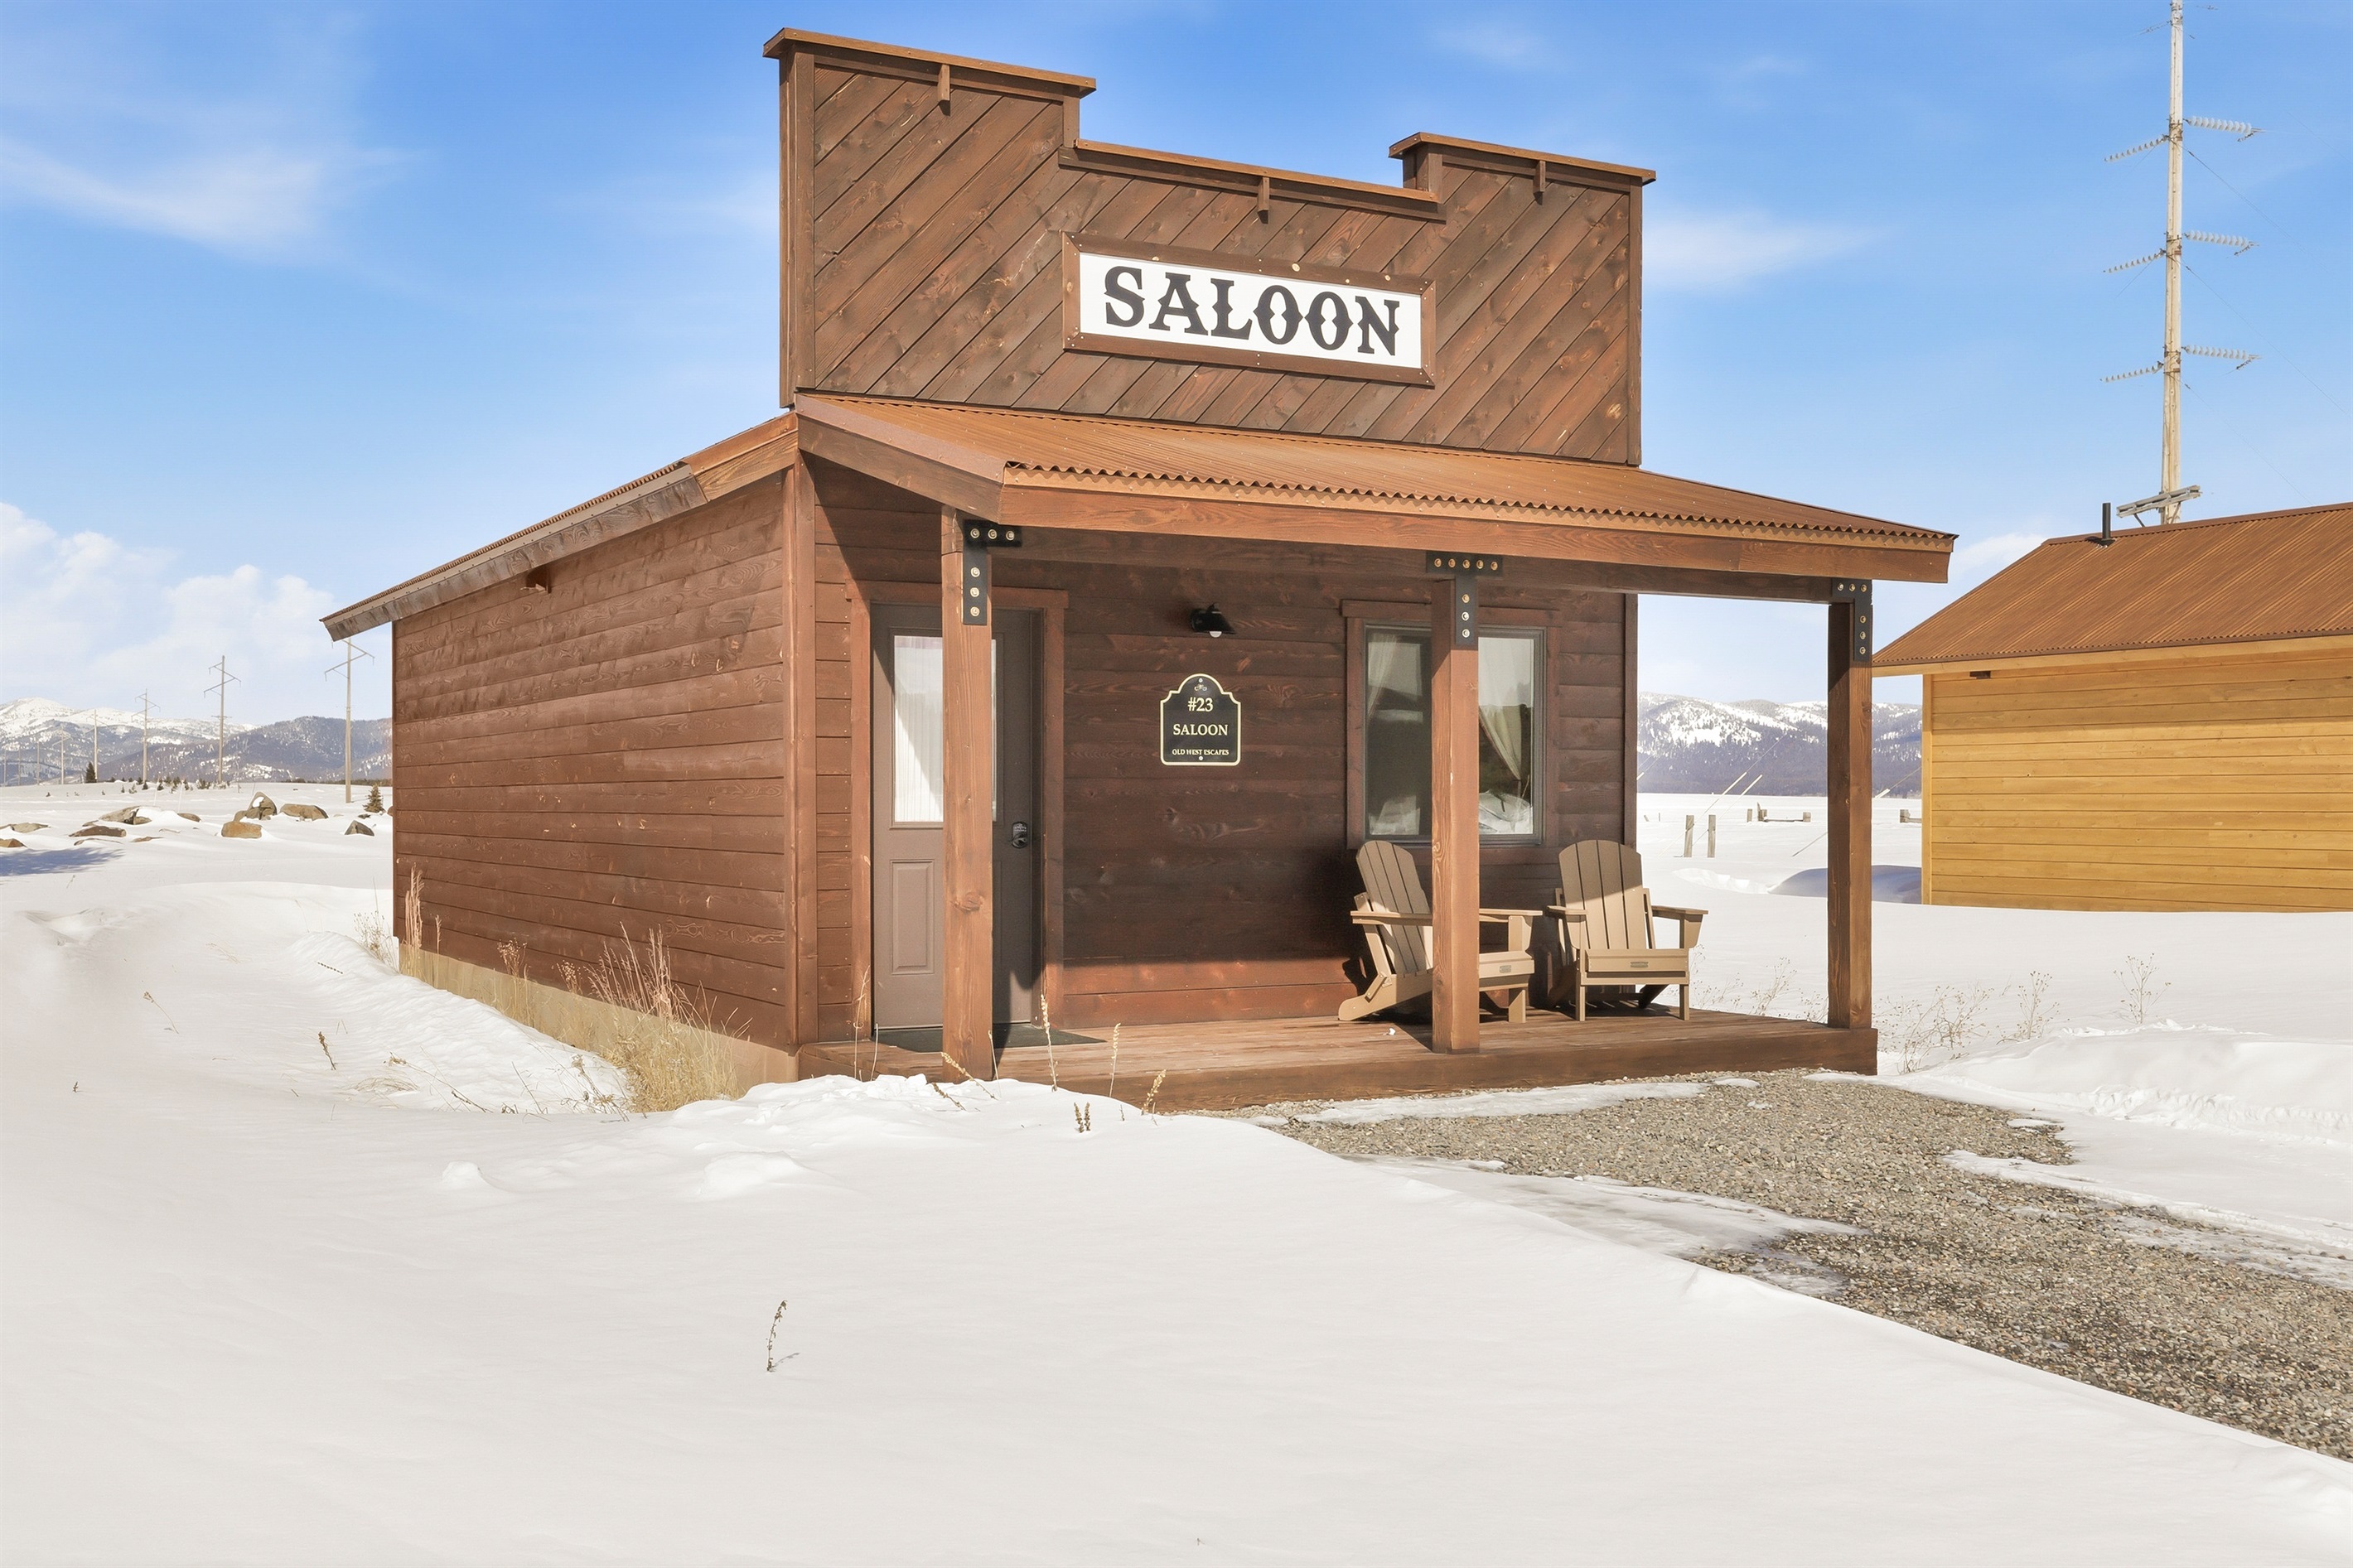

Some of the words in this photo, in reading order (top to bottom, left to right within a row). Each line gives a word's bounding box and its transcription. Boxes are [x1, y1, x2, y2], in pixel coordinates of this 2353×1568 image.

[1104, 265, 1400, 356] SALOON
[1187, 697, 1213, 712] #23
[1172, 723, 1229, 736] SALOON
